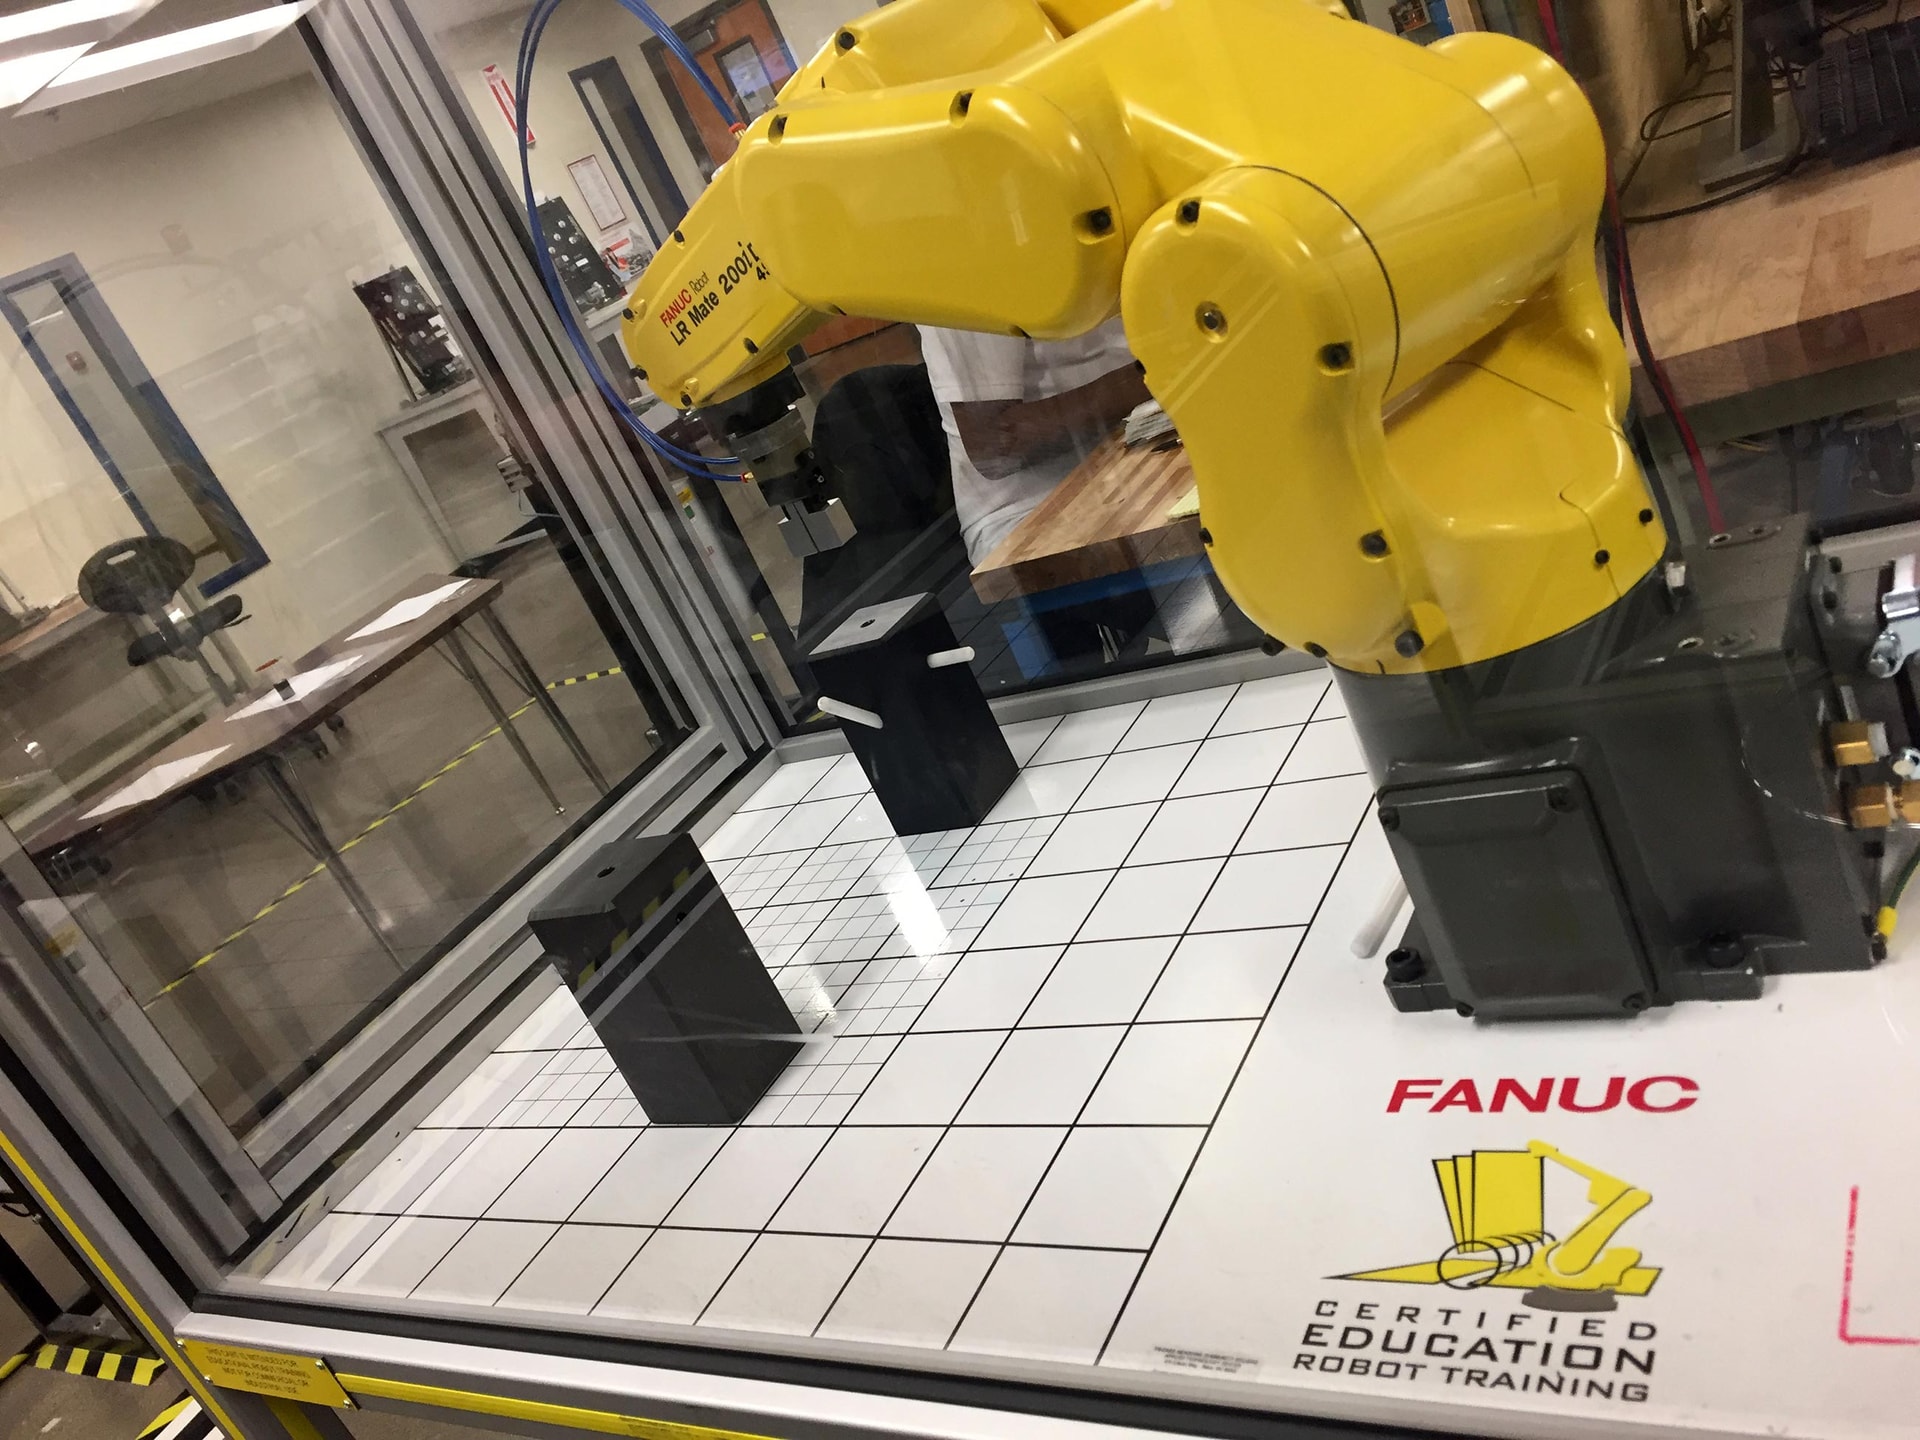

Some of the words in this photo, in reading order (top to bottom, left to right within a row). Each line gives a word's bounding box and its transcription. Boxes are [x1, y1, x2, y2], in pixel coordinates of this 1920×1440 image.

[659, 289, 692, 328] FANUC
[688, 271, 710, 295] Robot
[670, 321, 692, 346] LR
[687, 290, 720, 328] Mate
[1386, 1075, 1701, 1114] FANUC
[1314, 1299, 1658, 1341] CERTIFIED
[1301, 1323, 1656, 1375] EDUCATION
[1293, 1352, 1428, 1382] ROBOT
[1441, 1366, 1650, 1403] TRAINING
